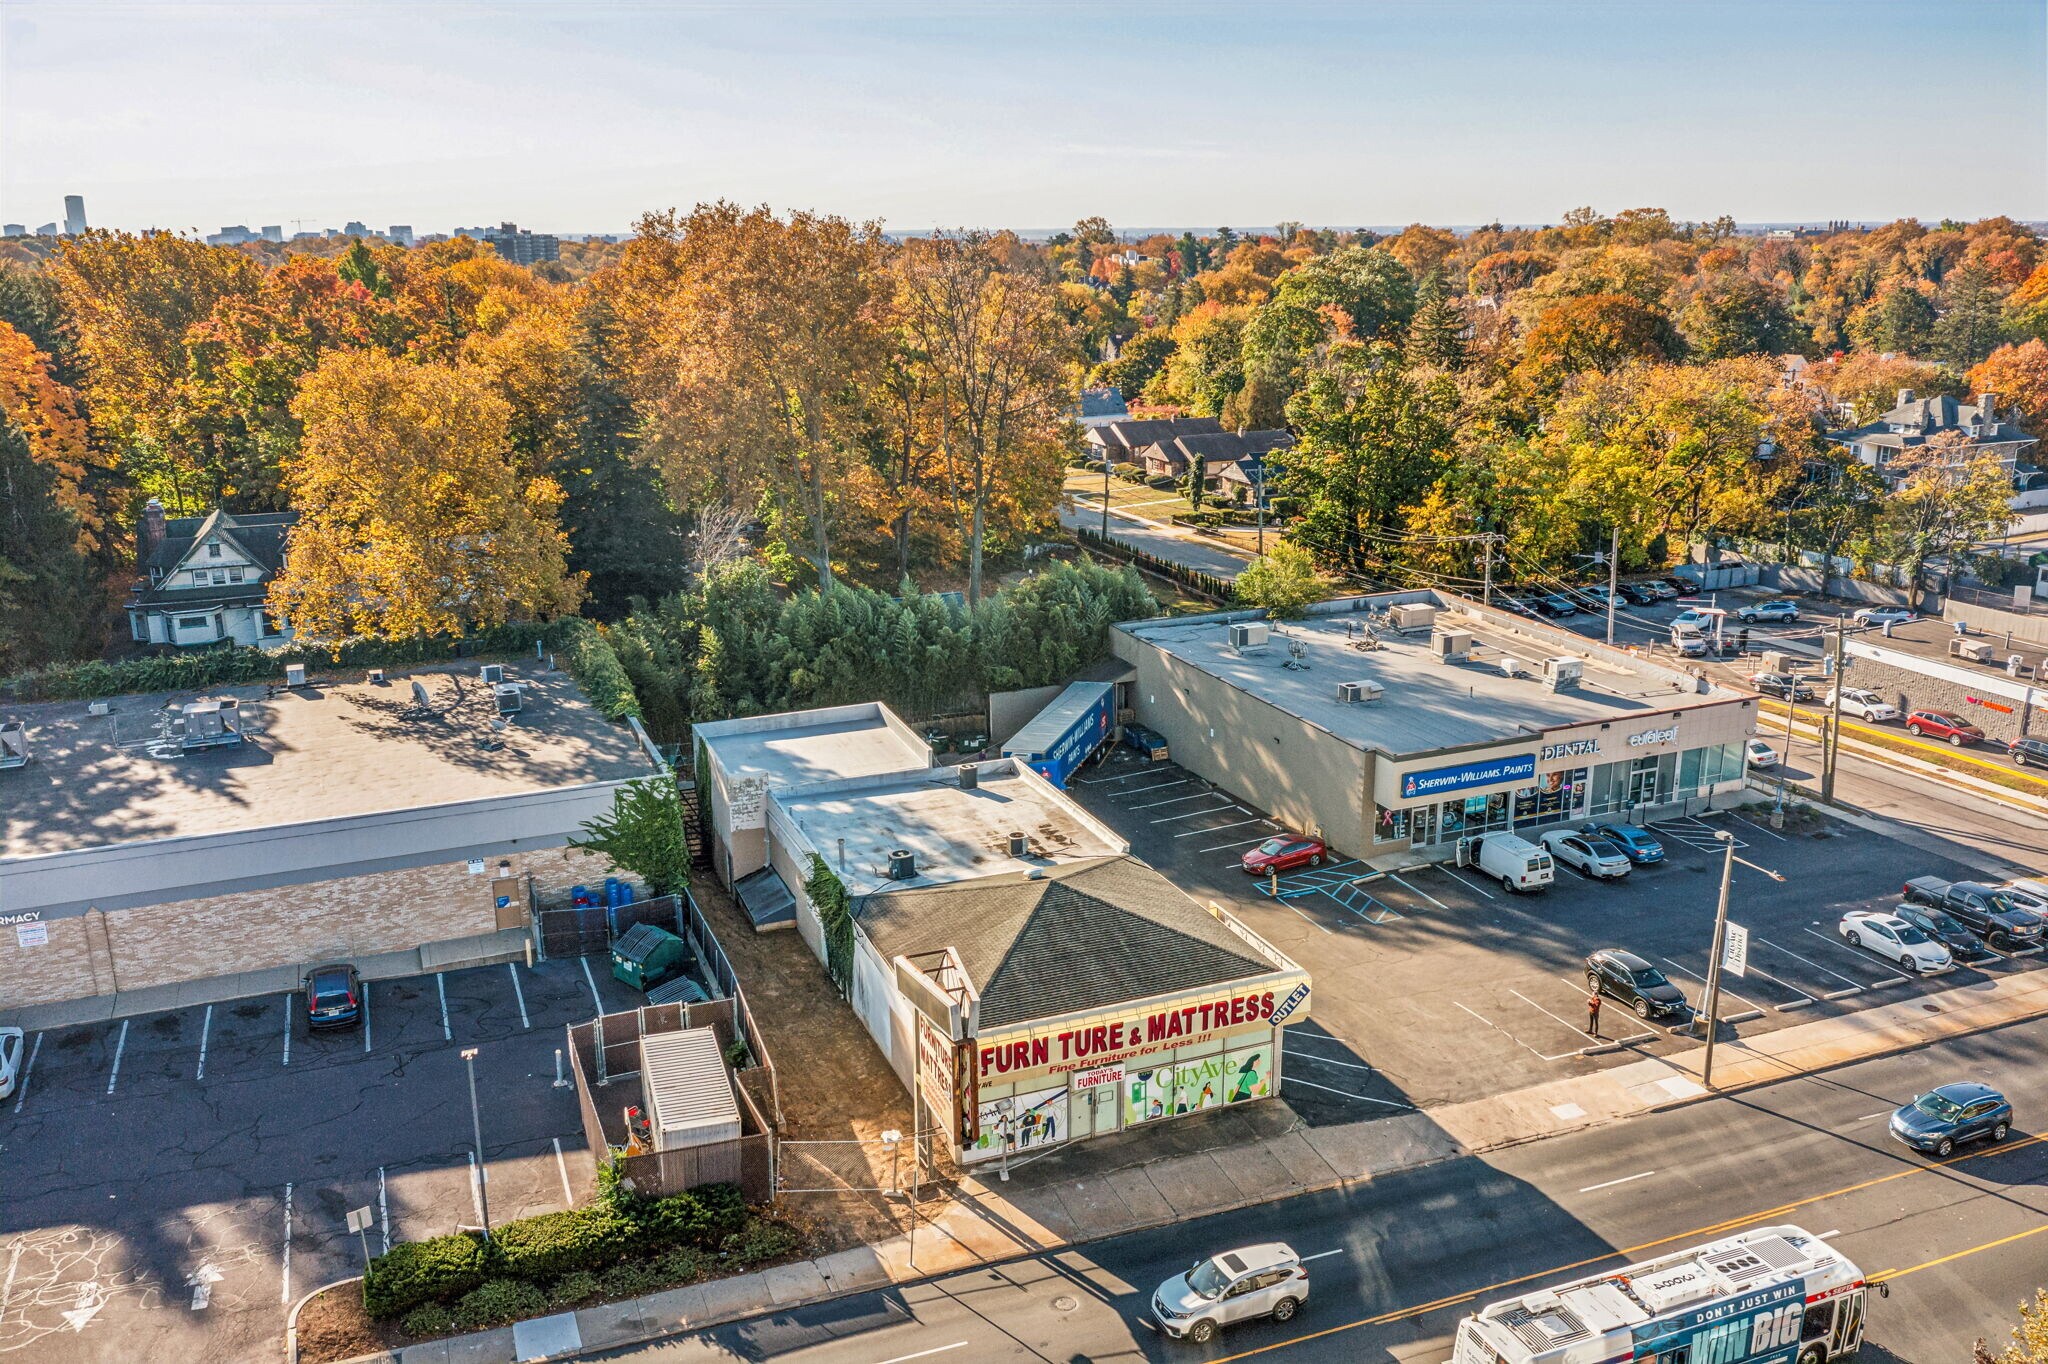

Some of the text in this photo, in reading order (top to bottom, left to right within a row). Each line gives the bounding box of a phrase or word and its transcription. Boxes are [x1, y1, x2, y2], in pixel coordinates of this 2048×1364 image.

[1630, 726, 1679, 747] curaleaf
[1542, 739, 1601, 761] DENTAL
[1503, 763, 1534, 776] PAINTS
[1272, 984, 1309, 1024] OUTLET
[1129, 1026, 1143, 1046] &
[1147, 991, 1275, 1043] MATTRESS
[1049, 1063, 1076, 1074] Fine
[1080, 1050, 1137, 1068] Furniture
[1140, 1046, 1158, 1055] for
[1163, 1040, 1193, 1050] Less
[1077, 1071, 1122, 1089] FURNITURE
[1087, 1067, 1114, 1077] TODAY'S
[1155, 1059, 1238, 1088] CityAve
[1833, 1283, 1855, 1296] SEPTA
[1696, 1285, 1796, 1323] DON'T JUST WIN
[1692, 1302, 1803, 1364] WIN BIG
